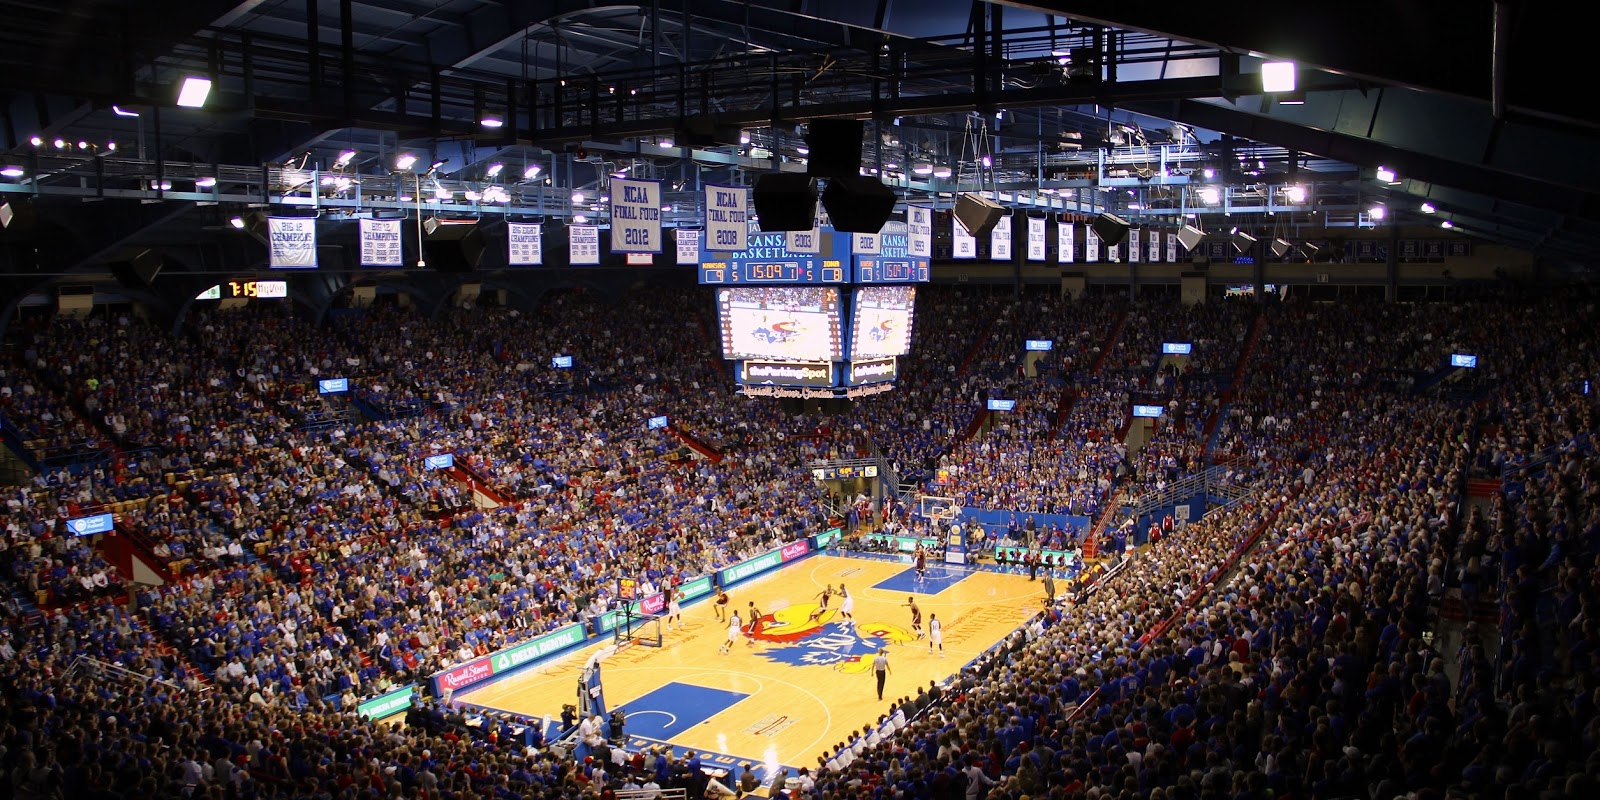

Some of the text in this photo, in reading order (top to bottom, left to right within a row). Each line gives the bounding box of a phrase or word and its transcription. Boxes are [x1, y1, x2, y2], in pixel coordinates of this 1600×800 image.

[624, 186, 648, 203] NCAA
[716, 192, 737, 208] NCAA
[614, 205, 658, 220] FINAL FOUR
[708, 209, 745, 222] FINAL FOUR
[282, 222, 303, 232] BIG 12
[372, 222, 382, 231] BIG
[272, 232, 312, 241] CHAMPIONS
[364, 232, 398, 241] CHAMPIONS
[625, 228, 648, 244] 2012
[717, 230, 737, 244] 2008
[795, 234, 812, 248] 2003
[860, 237, 873, 249] 2002
[914, 240, 924, 252] 1993
[716, 270, 722, 281] 9
[732, 271, 738, 281] 5
[753, 265, 782, 278] 15:09
[791, 269, 794, 278] 1
[806, 270, 813, 280] 5
[833, 269, 840, 280] 8
[229, 282, 257, 297] 7:15
[749, 366, 826, 379] theParkingSpot
[744, 386, 834, 399] Russell Stover Candies
[808, 632, 856, 651] KU
[511, 645, 537, 665] DELTA
[539, 633, 574, 655] DENTAL
[445, 662, 489, 686] Russell Stover
[460, 672, 488, 686] CANDIES
